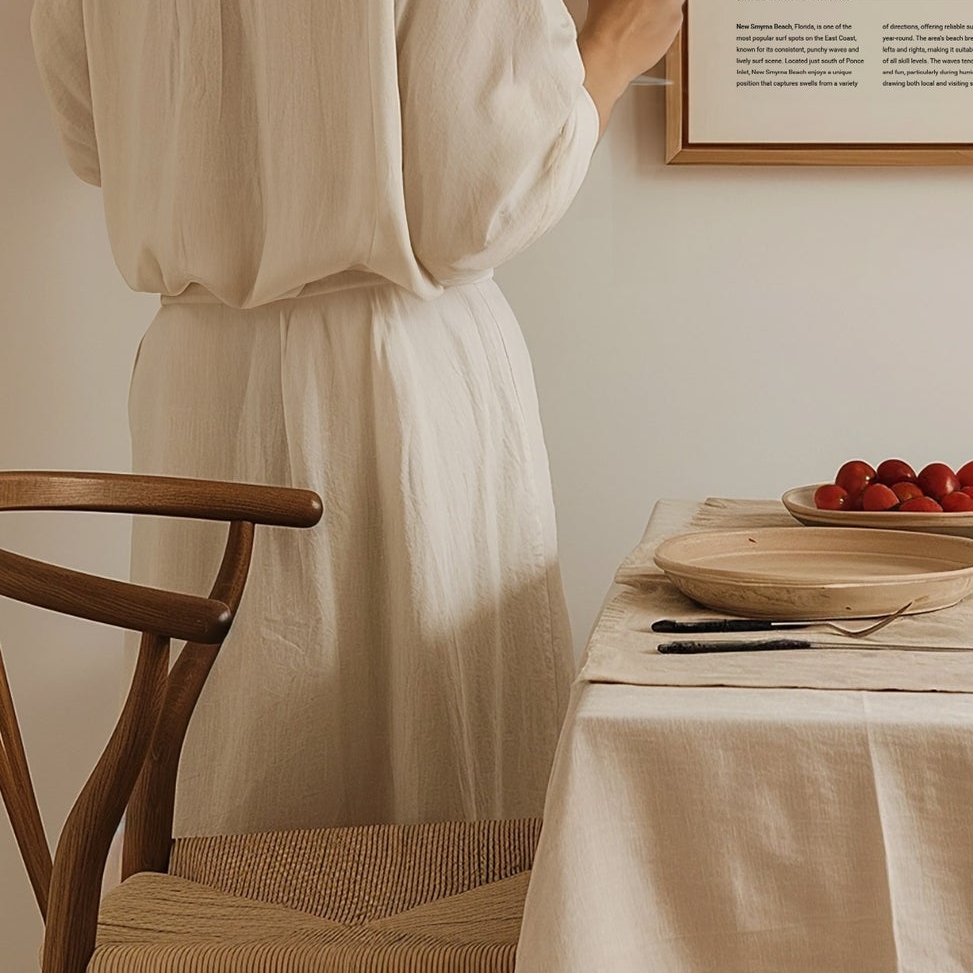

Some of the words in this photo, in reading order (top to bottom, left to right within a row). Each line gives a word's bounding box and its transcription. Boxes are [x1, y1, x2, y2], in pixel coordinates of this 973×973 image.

[750, 23, 773, 32] Smyrna
[920, 23, 944, 32] offering
[735, 34, 752, 42] most
[752, 34, 775, 43] popular
[775, 34, 787, 42] surf
[788, 34, 805, 43] spots
[814, 34, 824, 42] the
[824, 34, 838, 42] East
[915, 34, 927, 42] The
[945, 34, 964, 42] beach
[806, 46, 828, 55] punchy
[927, 46, 949, 55] making
[736, 57, 751, 66] lively
[808, 57, 821, 66] just
[765, 68, 788, 77] Smyrna
[832, 68, 852, 77] unique
[906, 68, 939, 77] particularly
[939, 68, 959, 77] during
[736, 79, 760, 88] position
[760, 79, 773, 87] that
[773, 79, 799, 88] captures
[799, 79, 818, 87] swells
[818, 79, 833, 87] from
[838, 79, 859, 88] variety
[882, 79, 906, 88] drawing
[906, 79, 920, 87] both
[920, 79, 935, 87] local
[935, 79, 948, 87] and
[948, 79, 969, 88] visiting
